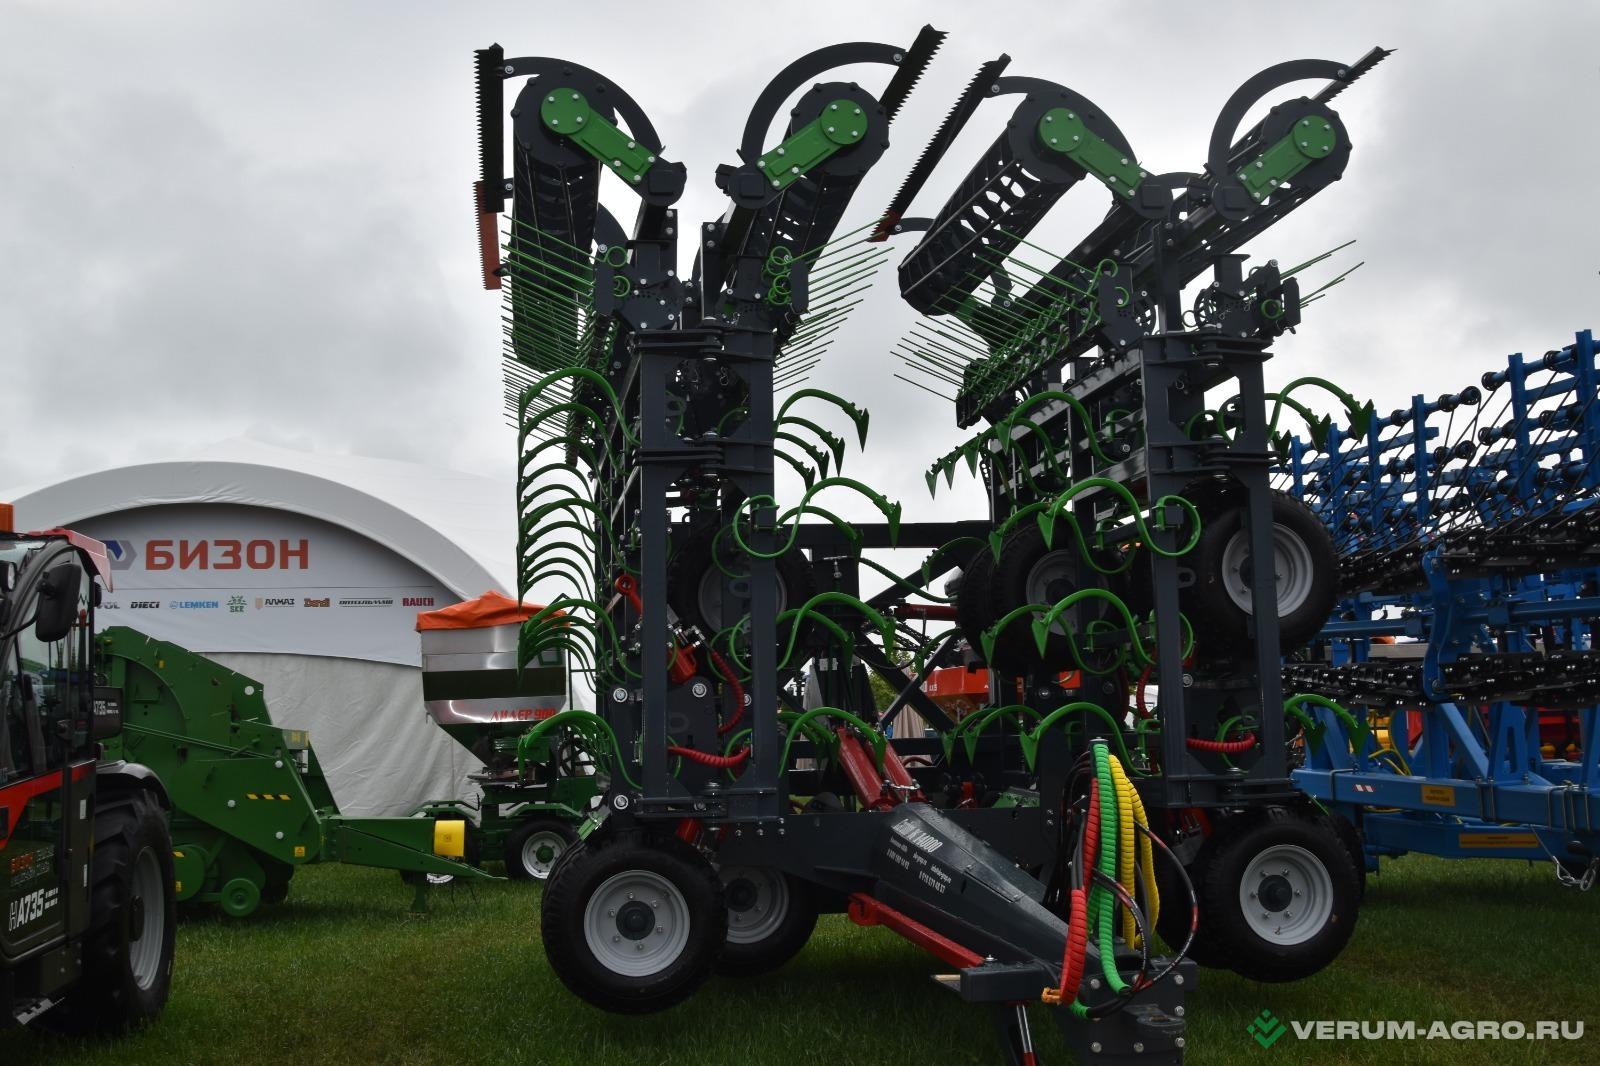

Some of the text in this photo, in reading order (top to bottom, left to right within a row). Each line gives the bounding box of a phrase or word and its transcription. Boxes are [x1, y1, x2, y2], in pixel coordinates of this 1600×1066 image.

[145, 539, 309, 571] БИЗОН
[180, 601, 219, 609] LEMKEN
[402, 597, 434, 607] RAUCH
